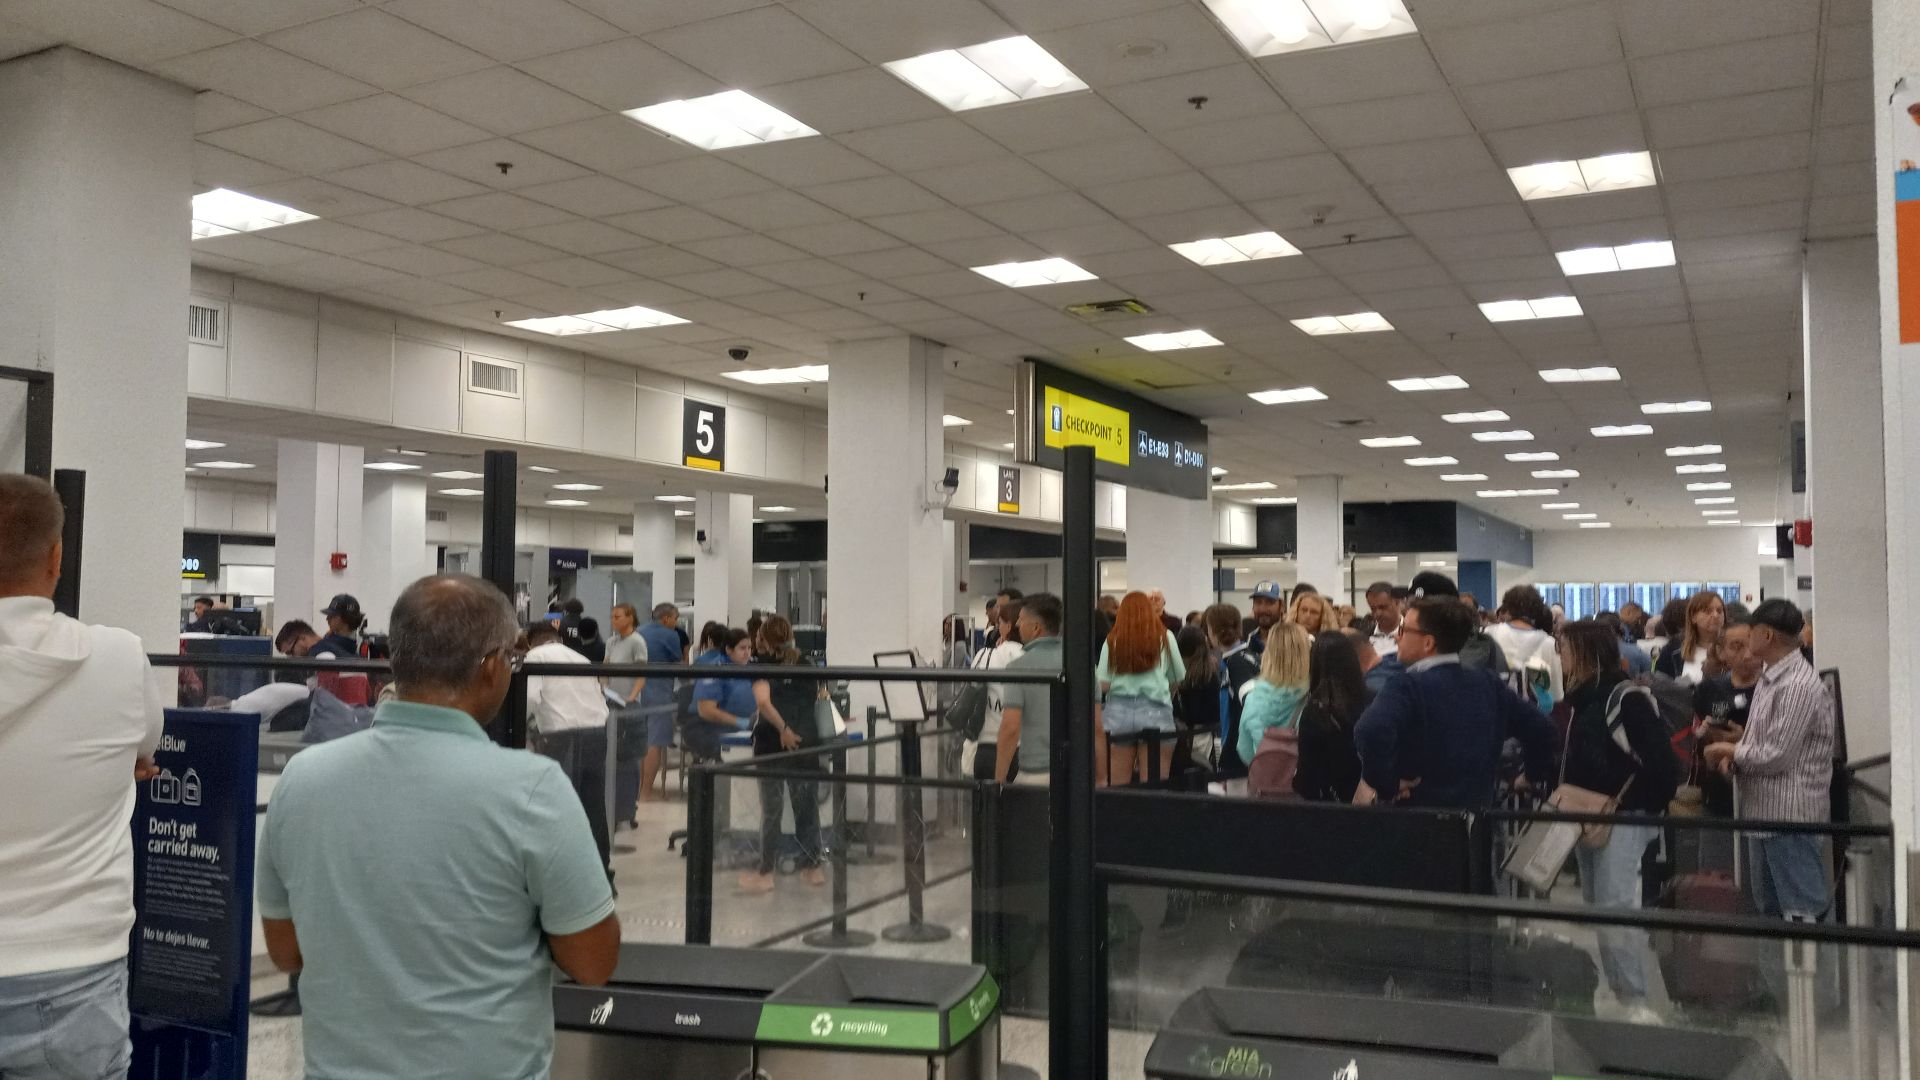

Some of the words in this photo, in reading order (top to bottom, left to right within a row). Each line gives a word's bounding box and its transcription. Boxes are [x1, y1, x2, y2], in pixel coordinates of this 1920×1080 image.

[696, 410, 714, 454] 5
[1066, 414, 1112, 440] CHECKPOINT
[1117, 428, 1122, 445] 5
[1005, 480, 1012, 501] 3
[149, 816, 178, 836] Don't
[180, 822, 197, 840] get
[147, 838, 188, 857] carried
[189, 843, 220, 864] away.
[143, 926, 155, 940] No
[156, 928, 164, 942] te
[165, 930, 186, 946] dejes
[187, 932, 210, 950] llevar.
[675, 1011, 701, 1026] trash
[840, 1020, 888, 1036] recycling
[1225, 1046, 1259, 1064] MIA
